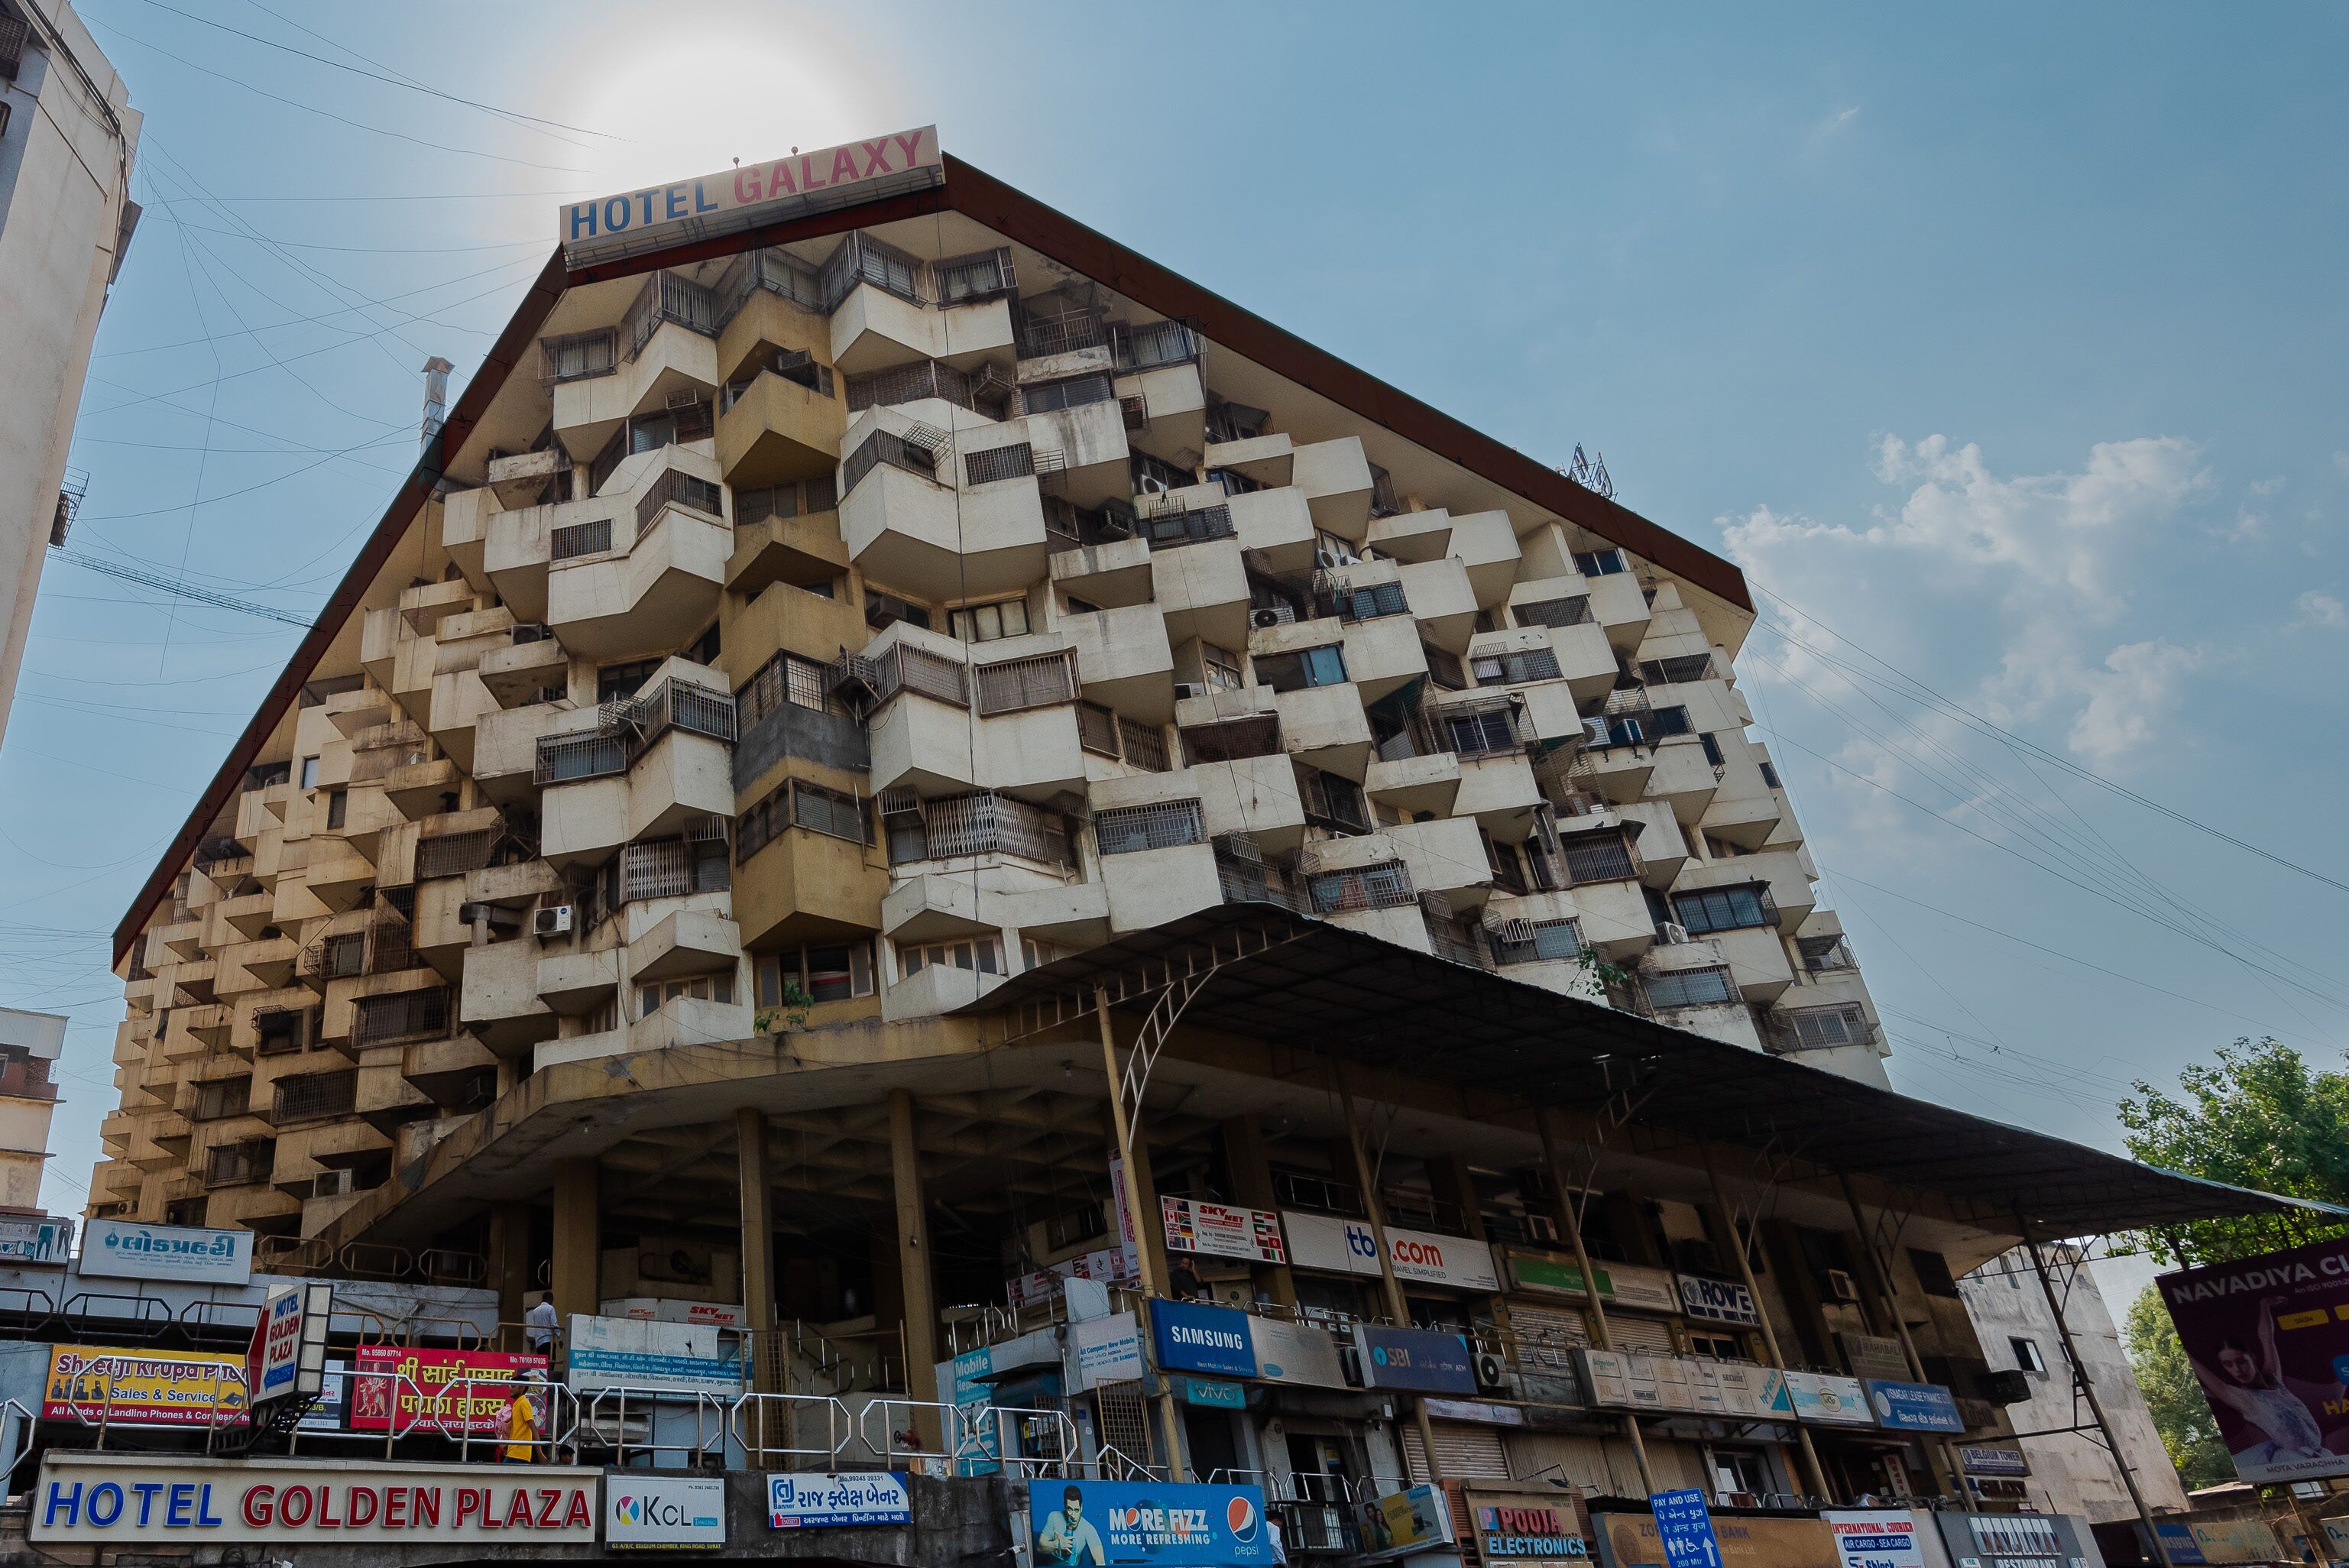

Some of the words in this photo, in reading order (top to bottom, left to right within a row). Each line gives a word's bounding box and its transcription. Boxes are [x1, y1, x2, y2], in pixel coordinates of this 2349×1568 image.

[571, 181, 718, 240] HOTEL
[734, 131, 923, 204] GALAXY
[1346, 1226, 1443, 1267] tb.com
[1392, 1265, 1412, 1275] RAVEL
[1413, 1268, 1447, 1278] SIMPLIFIED
[2172, 1262, 2317, 1304] NAVADIYA
[274, 1293, 299, 1319] HOTEL
[270, 1314, 300, 1342] GOLDEN
[1087, 1345, 1107, 1353] Company
[1119, 1336, 1136, 1345] Mobile
[1171, 1326, 1244, 1350] SAMSUNG
[269, 1339, 293, 1365] PLAZA
[1387, 1347, 1411, 1368] SBI
[135, 1360, 196, 1383] Krupa
[396, 1356, 419, 1383] श्री
[956, 1355, 988, 1378] Mobile
[111, 1388, 148, 1400] Sales
[153, 1388, 162, 1400] &
[167, 1389, 215, 1402] Service
[1196, 1383, 1236, 1400] vivo
[401, 1395, 453, 1414] पराठा
[51, 1407, 65, 1415] All
[67, 1407, 94, 1416] Knds
[109, 1408, 147, 1417] Landline
[150, 1410, 183, 1419] Phones
[195, 1412, 233, 1422] Corless
[1970, 1449, 2000, 1460] BELGIUM
[1999, 1451, 2021, 1461] TOWER
[2266, 1464, 2292, 1473] MOTA
[2292, 1459, 2345, 1469] VARACHHA
[798, 1490, 824, 1508] રાજ
[866, 1483, 899, 1505] બેનર
[1654, 1498, 1667, 1508] PAY
[1669, 1496, 1683, 1505] AND
[1684, 1493, 1700, 1503] USE
[43, 1481, 223, 1527] HOTEL
[241, 1483, 442, 1528] GOLDEN
[454, 1486, 593, 1528] PLAZA
[831, 1515, 847, 1523] બેનર
[877, 1513, 889, 1521] માટે
[891, 1511, 905, 1521] મળો
[1168, 1509, 1209, 1531] FIZZ
[1720, 1524, 1751, 1539] BANK
[1831, 1522, 1884, 1534] INTERNATIONAL
[1886, 1521, 1914, 1533] COURIER
[1111, 1534, 1142, 1545] MORE
[1146, 1534, 1210, 1545] REFRESHING
[1489, 1537, 1586, 1555] ELECTRONICS
[1845, 1539, 1855, 1549] AIR
[1855, 1539, 1875, 1549] CARGO
[1879, 1538, 1890, 1548] SEA
[1891, 1537, 1910, 1547] CARGO
[2163, 1536, 2195, 1549] MSUNG
[1234, 1545, 1259, 1557] pepsi
[1677, 1559, 1689, 1568] 200
